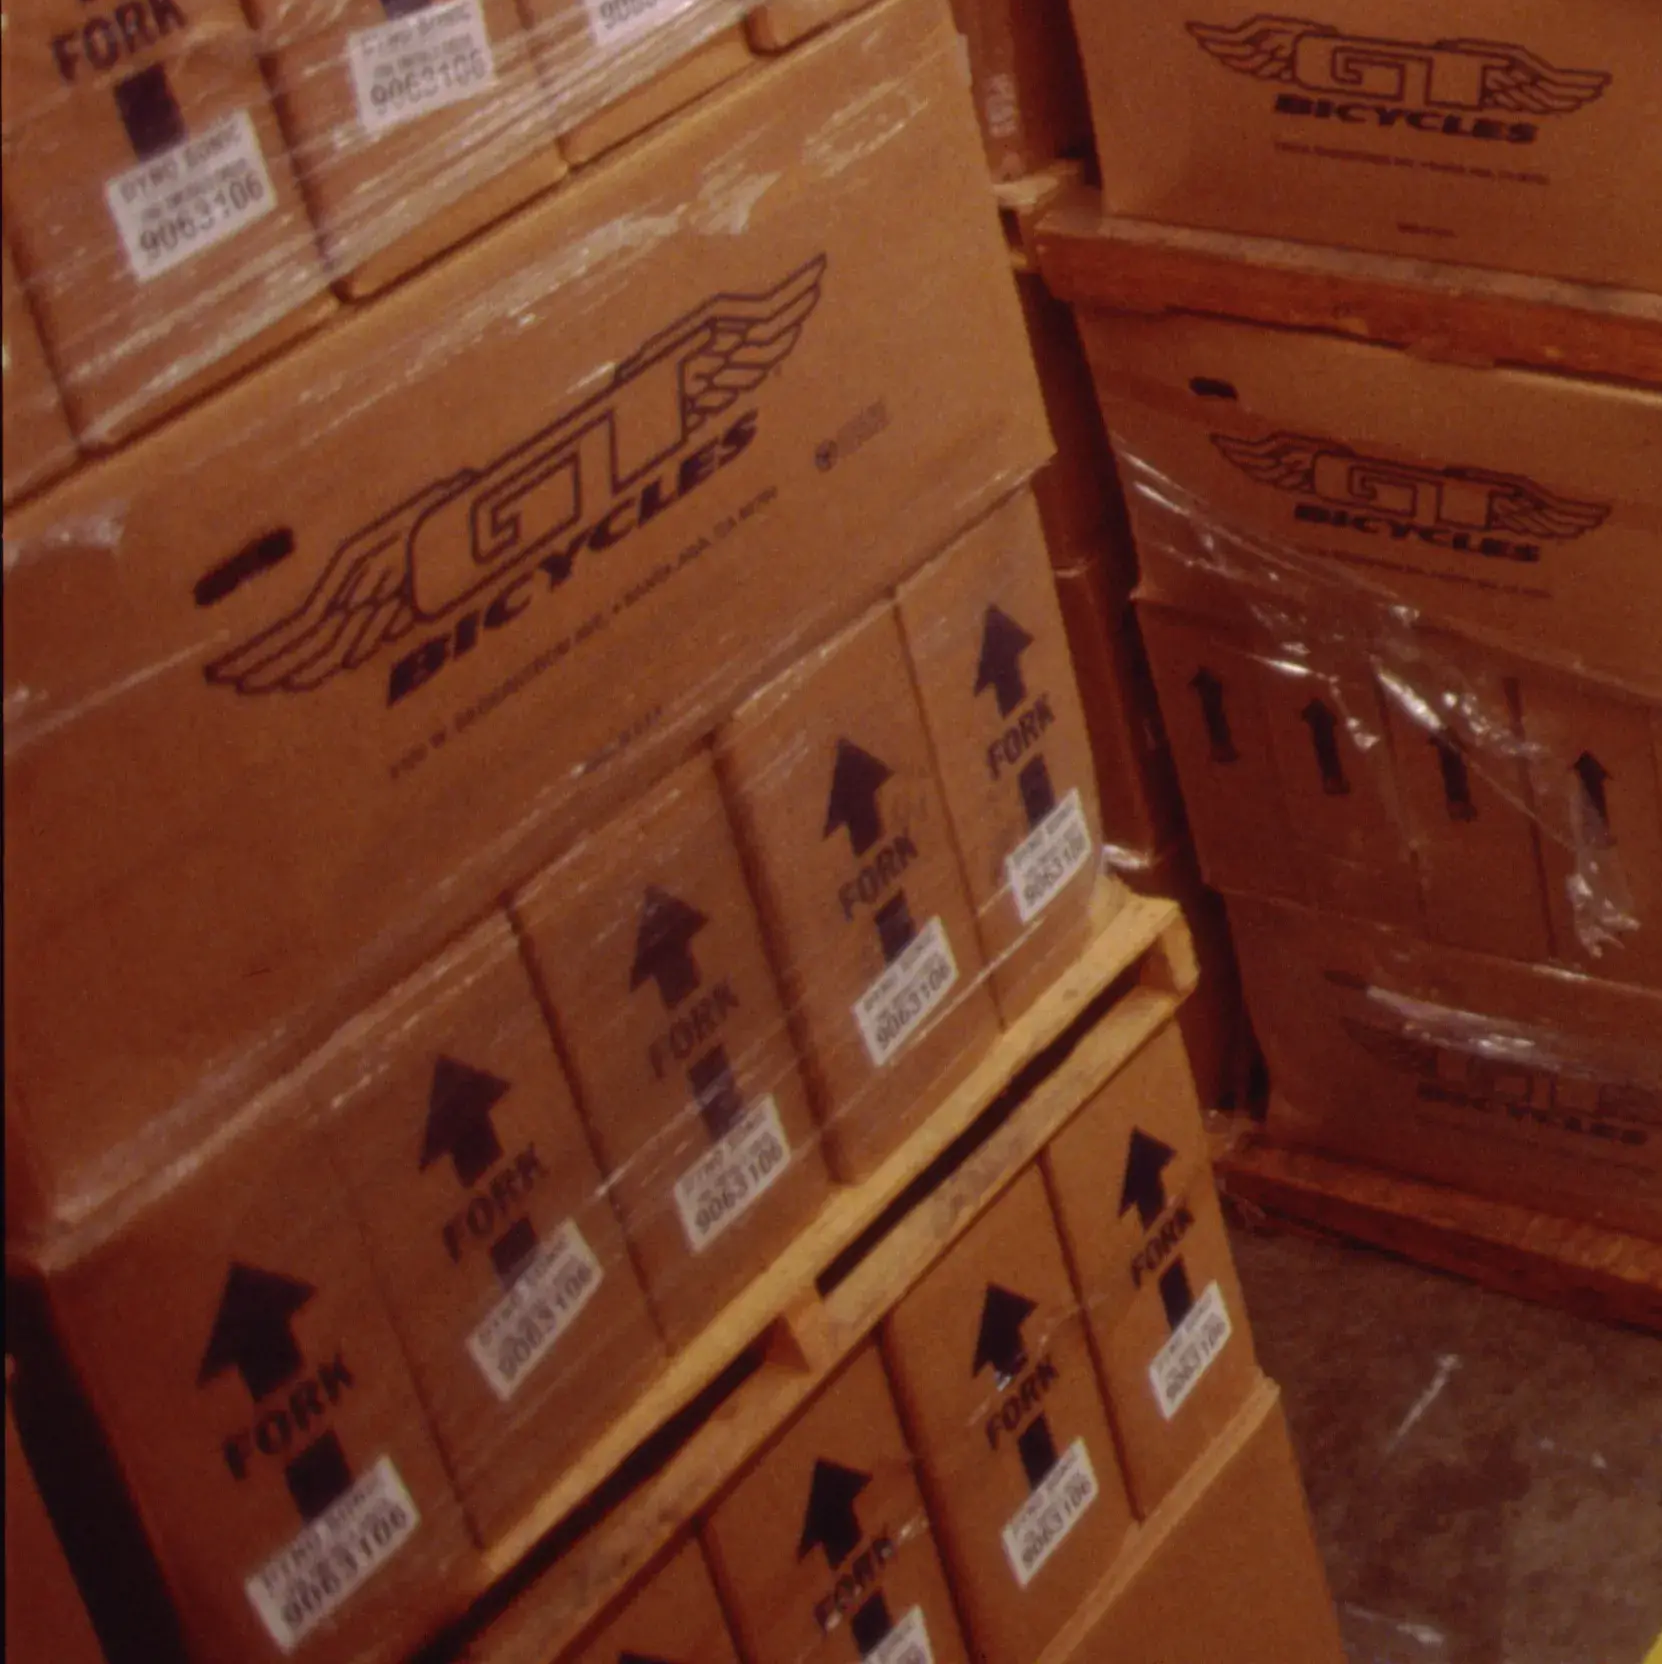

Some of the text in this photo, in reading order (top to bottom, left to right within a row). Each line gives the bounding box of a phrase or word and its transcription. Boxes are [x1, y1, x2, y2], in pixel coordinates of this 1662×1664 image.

[1293, 31, 1512, 112] GT
[1274, 94, 1537, 144] BICYCLES
[1294, 504, 1540, 563] BICYCLES
[1311, 448, 1520, 533] GT
[388, 410, 760, 707] BICYCLES
[985, 694, 1058, 782] FORK
[836, 829, 920, 923] FORK
[647, 975, 742, 1081] FORK
[440, 1139, 549, 1261] FORK
[1130, 1200, 1196, 1288] FORK
[220, 1349, 357, 1482] FORK
[983, 1354, 1062, 1451] FORK
